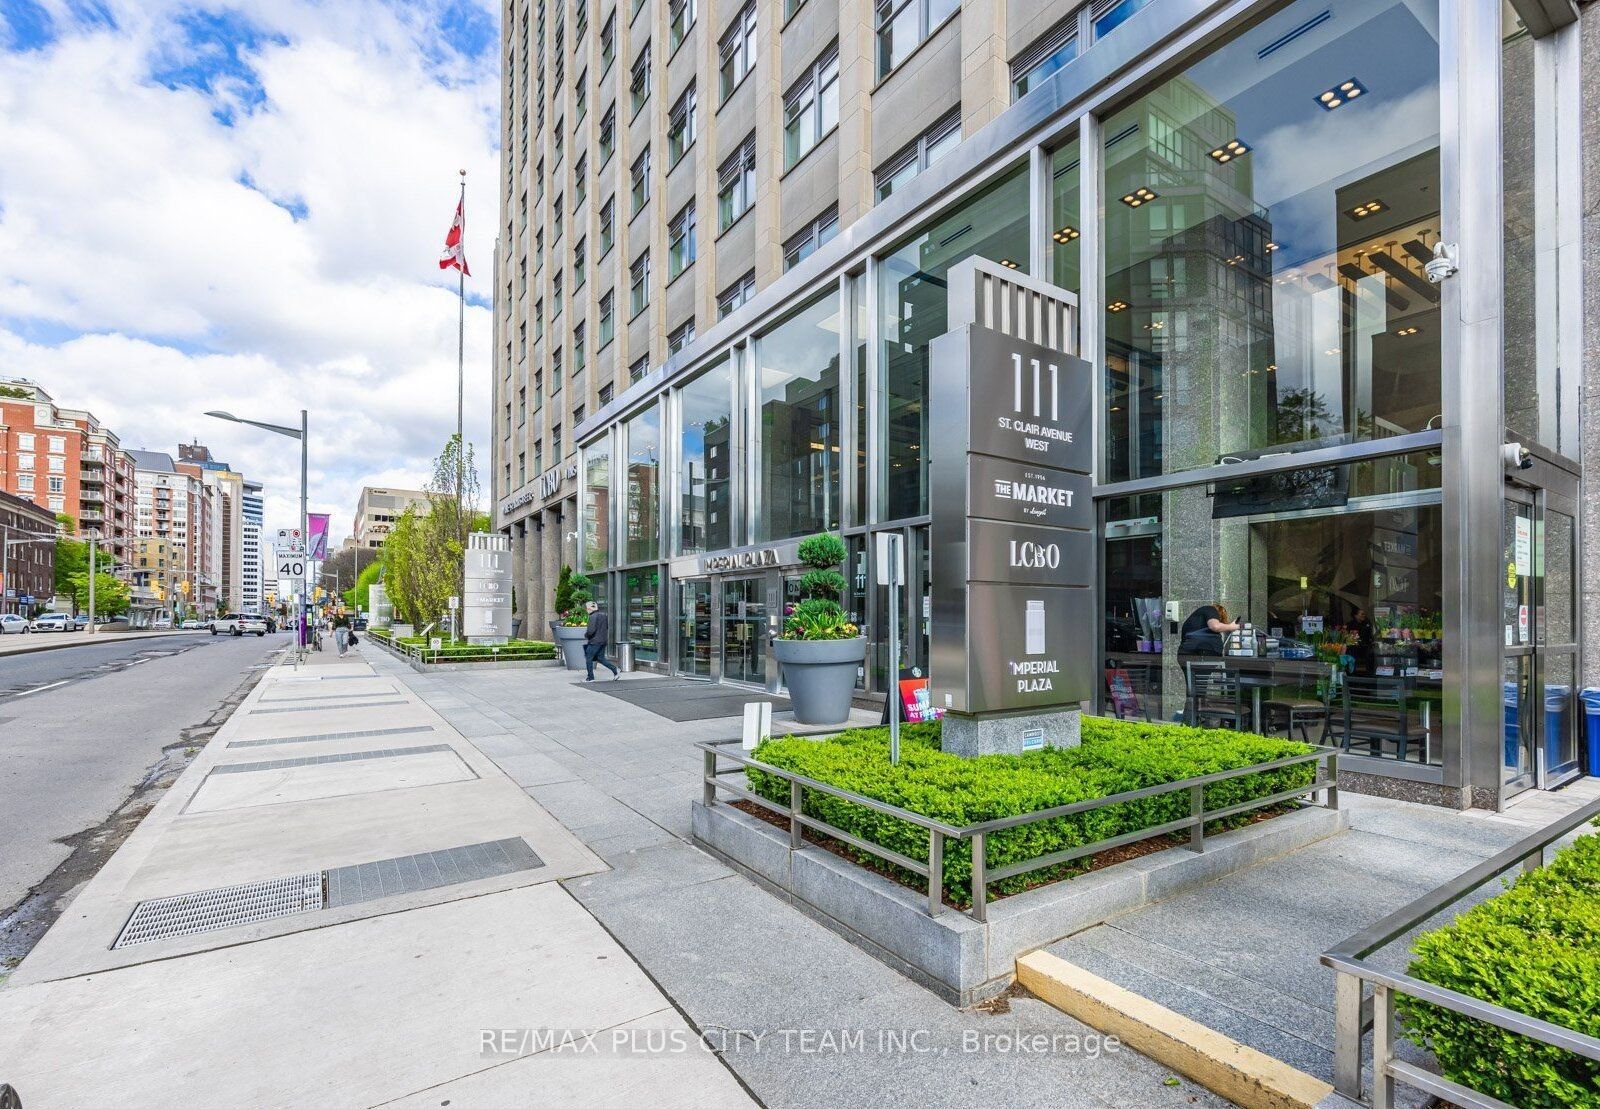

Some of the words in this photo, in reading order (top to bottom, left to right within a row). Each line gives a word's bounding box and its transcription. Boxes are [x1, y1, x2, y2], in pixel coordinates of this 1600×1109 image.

[1011, 352, 1058, 421] 111
[998, 416, 1012, 430] ST.
[1014, 420, 1040, 436] CLAIR
[1041, 427, 1073, 443] AVENUE
[1024, 437, 1050, 452] WEST
[995, 483, 1011, 495] THE
[1012, 482, 1074, 507] MARKET
[480, 553, 499, 569] 111
[745, 549, 780, 568] PLAZA
[1009, 540, 1060, 569] LCBO
[280, 562, 303, 576] 40
[1017, 678, 1053, 693] PLAZA
